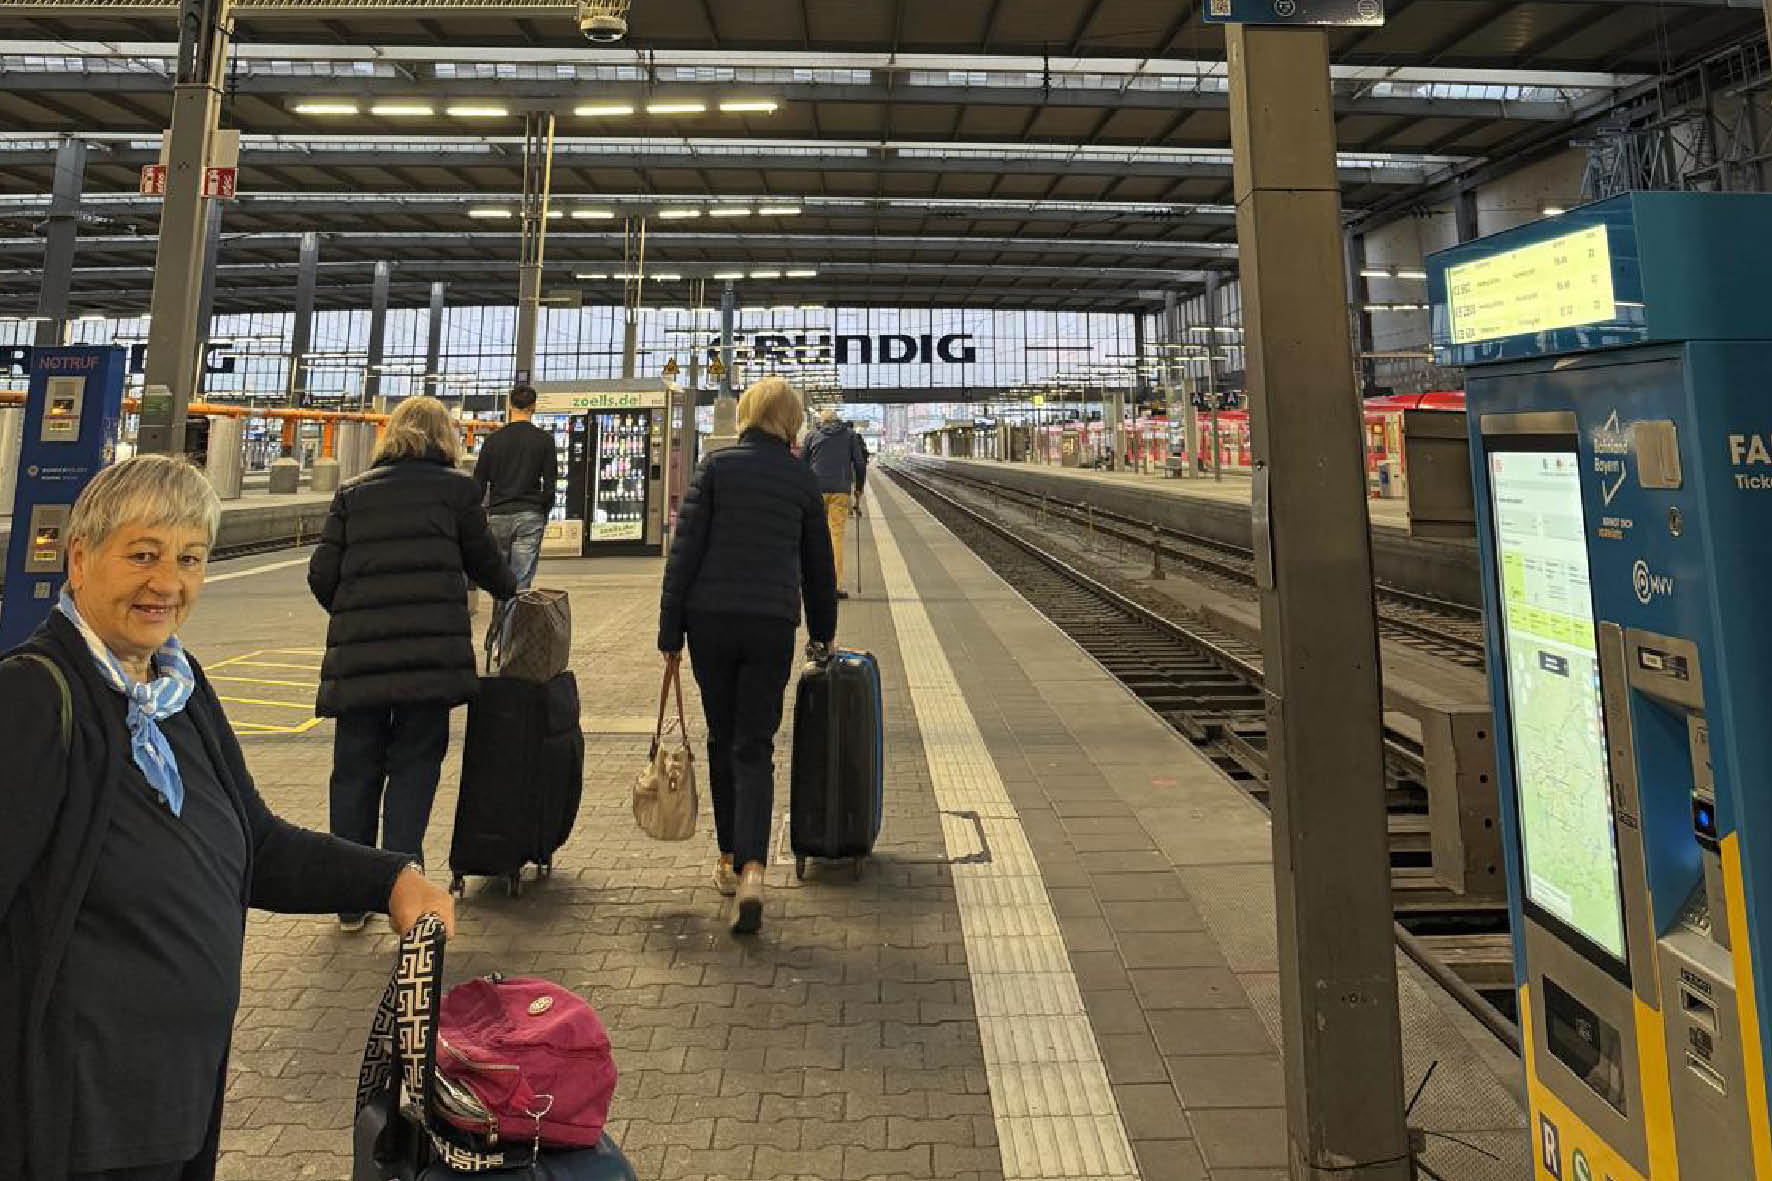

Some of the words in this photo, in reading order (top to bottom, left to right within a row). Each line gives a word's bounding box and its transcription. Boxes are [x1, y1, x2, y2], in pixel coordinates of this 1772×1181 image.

[40, 355, 100, 369] NOTRUF
[707, 335, 976, 364] GRUNDIG
[1729, 434, 1772, 465] FA
[1735, 474, 1772, 489] Tick
[1543, 1121, 1559, 1174] R
